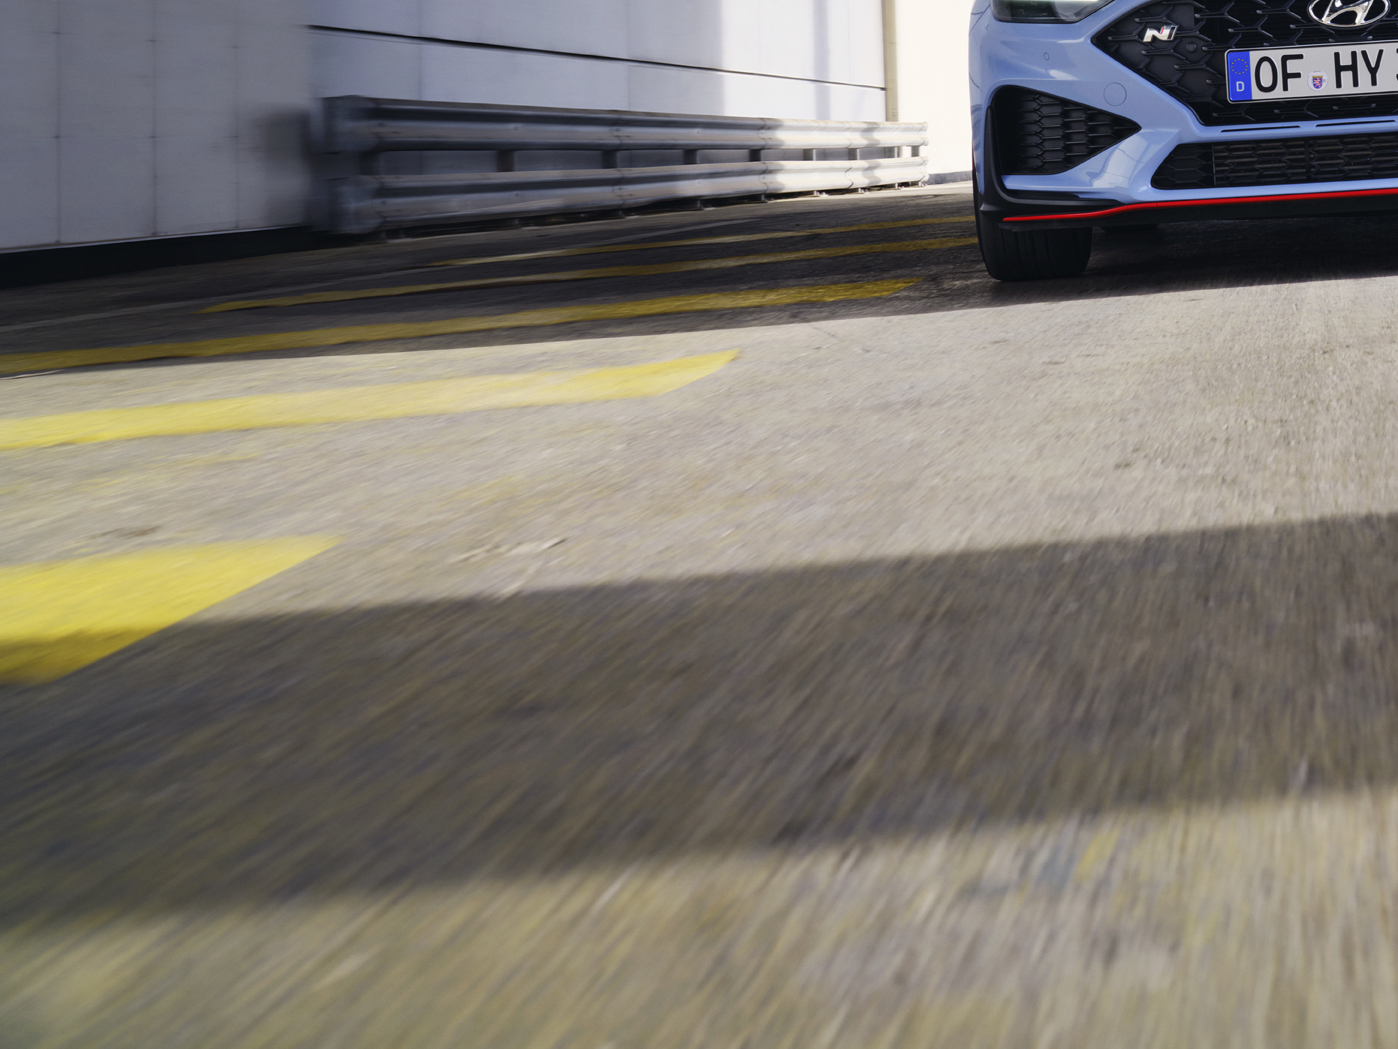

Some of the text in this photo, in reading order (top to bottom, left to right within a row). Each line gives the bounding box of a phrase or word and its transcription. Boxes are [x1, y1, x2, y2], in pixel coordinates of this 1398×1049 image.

[1143, 24, 1179, 42] N
[1255, 54, 1304, 93] OF
[1333, 48, 1384, 88] HY
[1236, 81, 1245, 92] D
